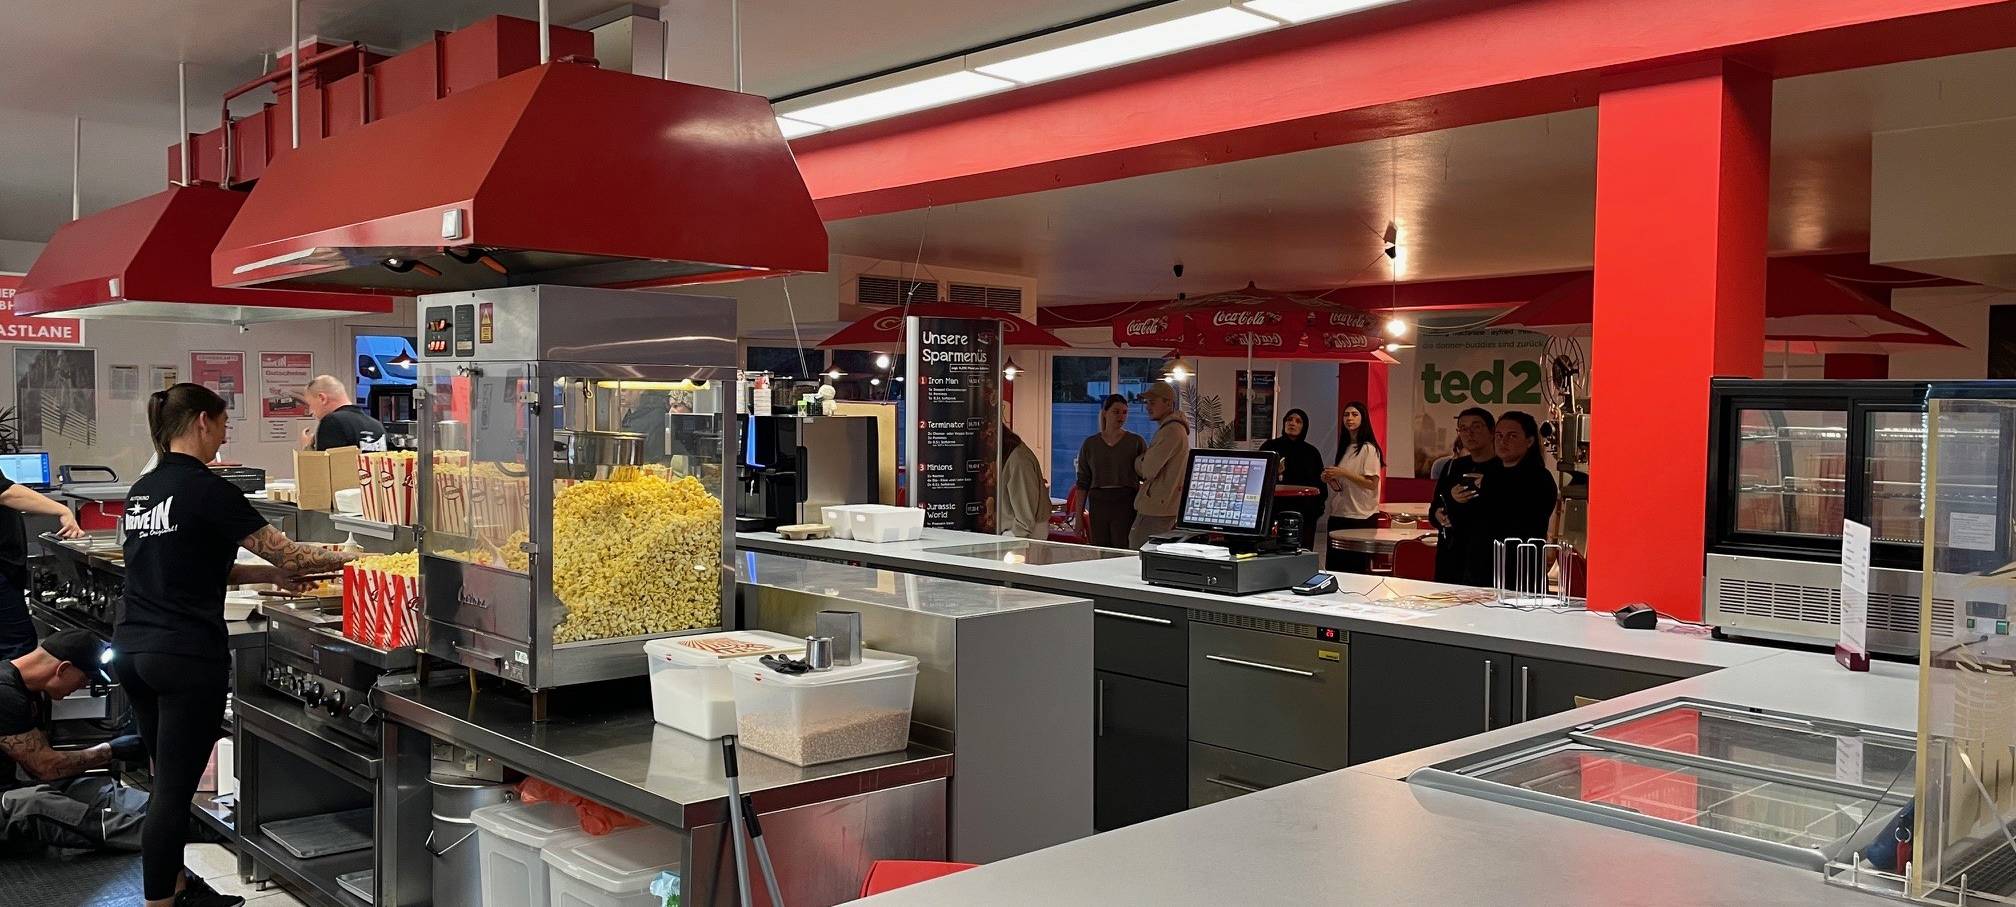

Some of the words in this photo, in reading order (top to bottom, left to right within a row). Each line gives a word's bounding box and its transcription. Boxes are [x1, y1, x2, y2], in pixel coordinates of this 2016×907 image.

[1213, 310, 1265, 326] Coca-Cola
[1127, 318, 1158, 336] Coca-Cola
[922, 331, 968, 345] Unsere
[922, 348, 987, 366] Sparmenüs
[928, 377, 944, 385] Iron
[945, 377, 959, 385] Man
[920, 421, 925, 429] 2
[927, 421, 965, 429] Terminator
